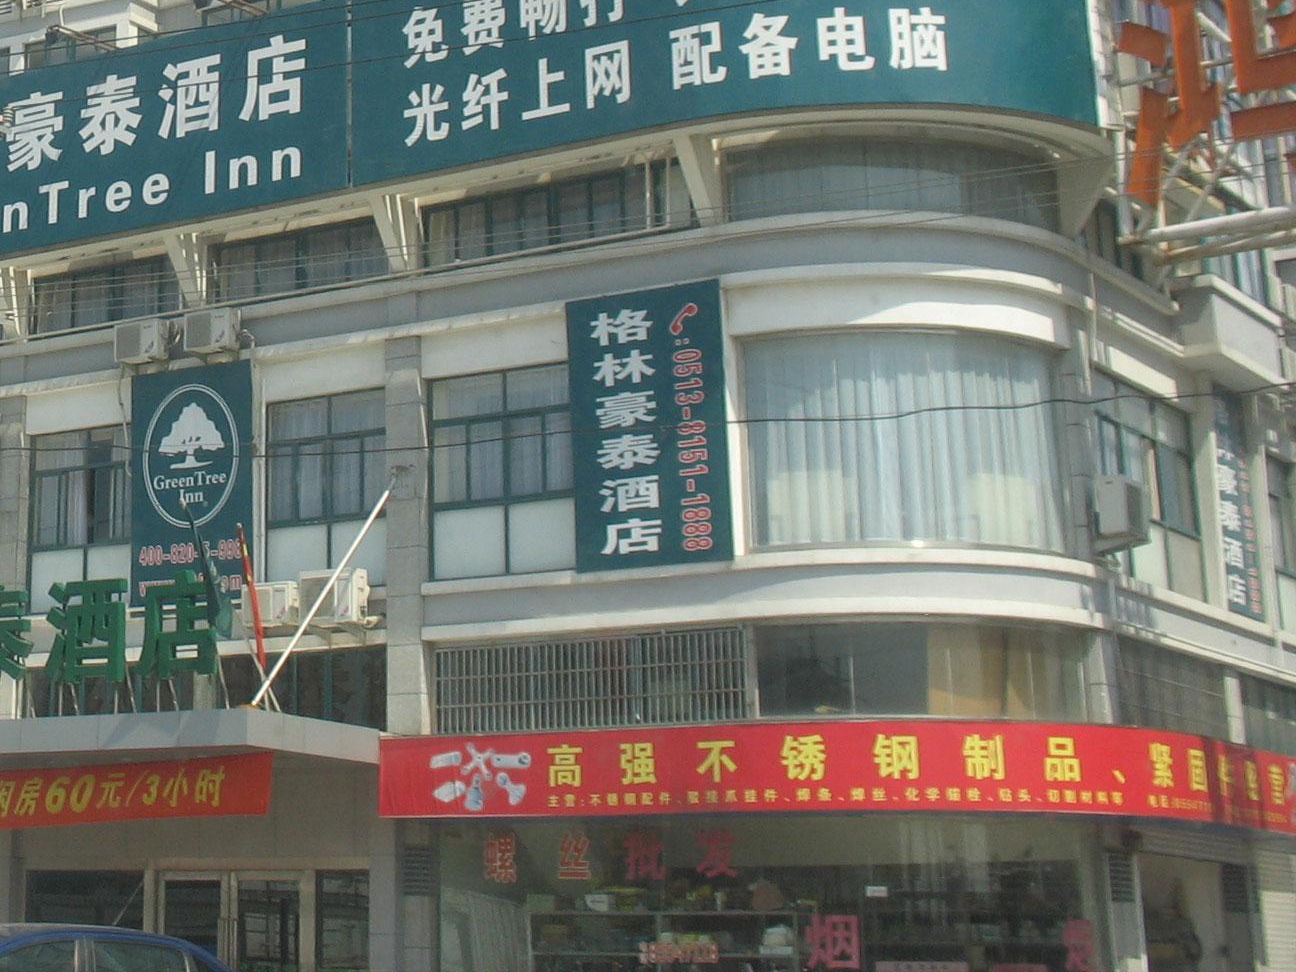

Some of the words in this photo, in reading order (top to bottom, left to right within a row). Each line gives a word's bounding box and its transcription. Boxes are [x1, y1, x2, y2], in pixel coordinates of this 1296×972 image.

[403, 40, 632, 147] 光纤上网
[669, 6, 948, 91] 配备电脑
[204, 143, 302, 195] Inn
[590, 309, 663, 556] 格林豪泰酒店
[154, 471, 227, 491] GreenTree
[179, 488, 204, 504] Inn
